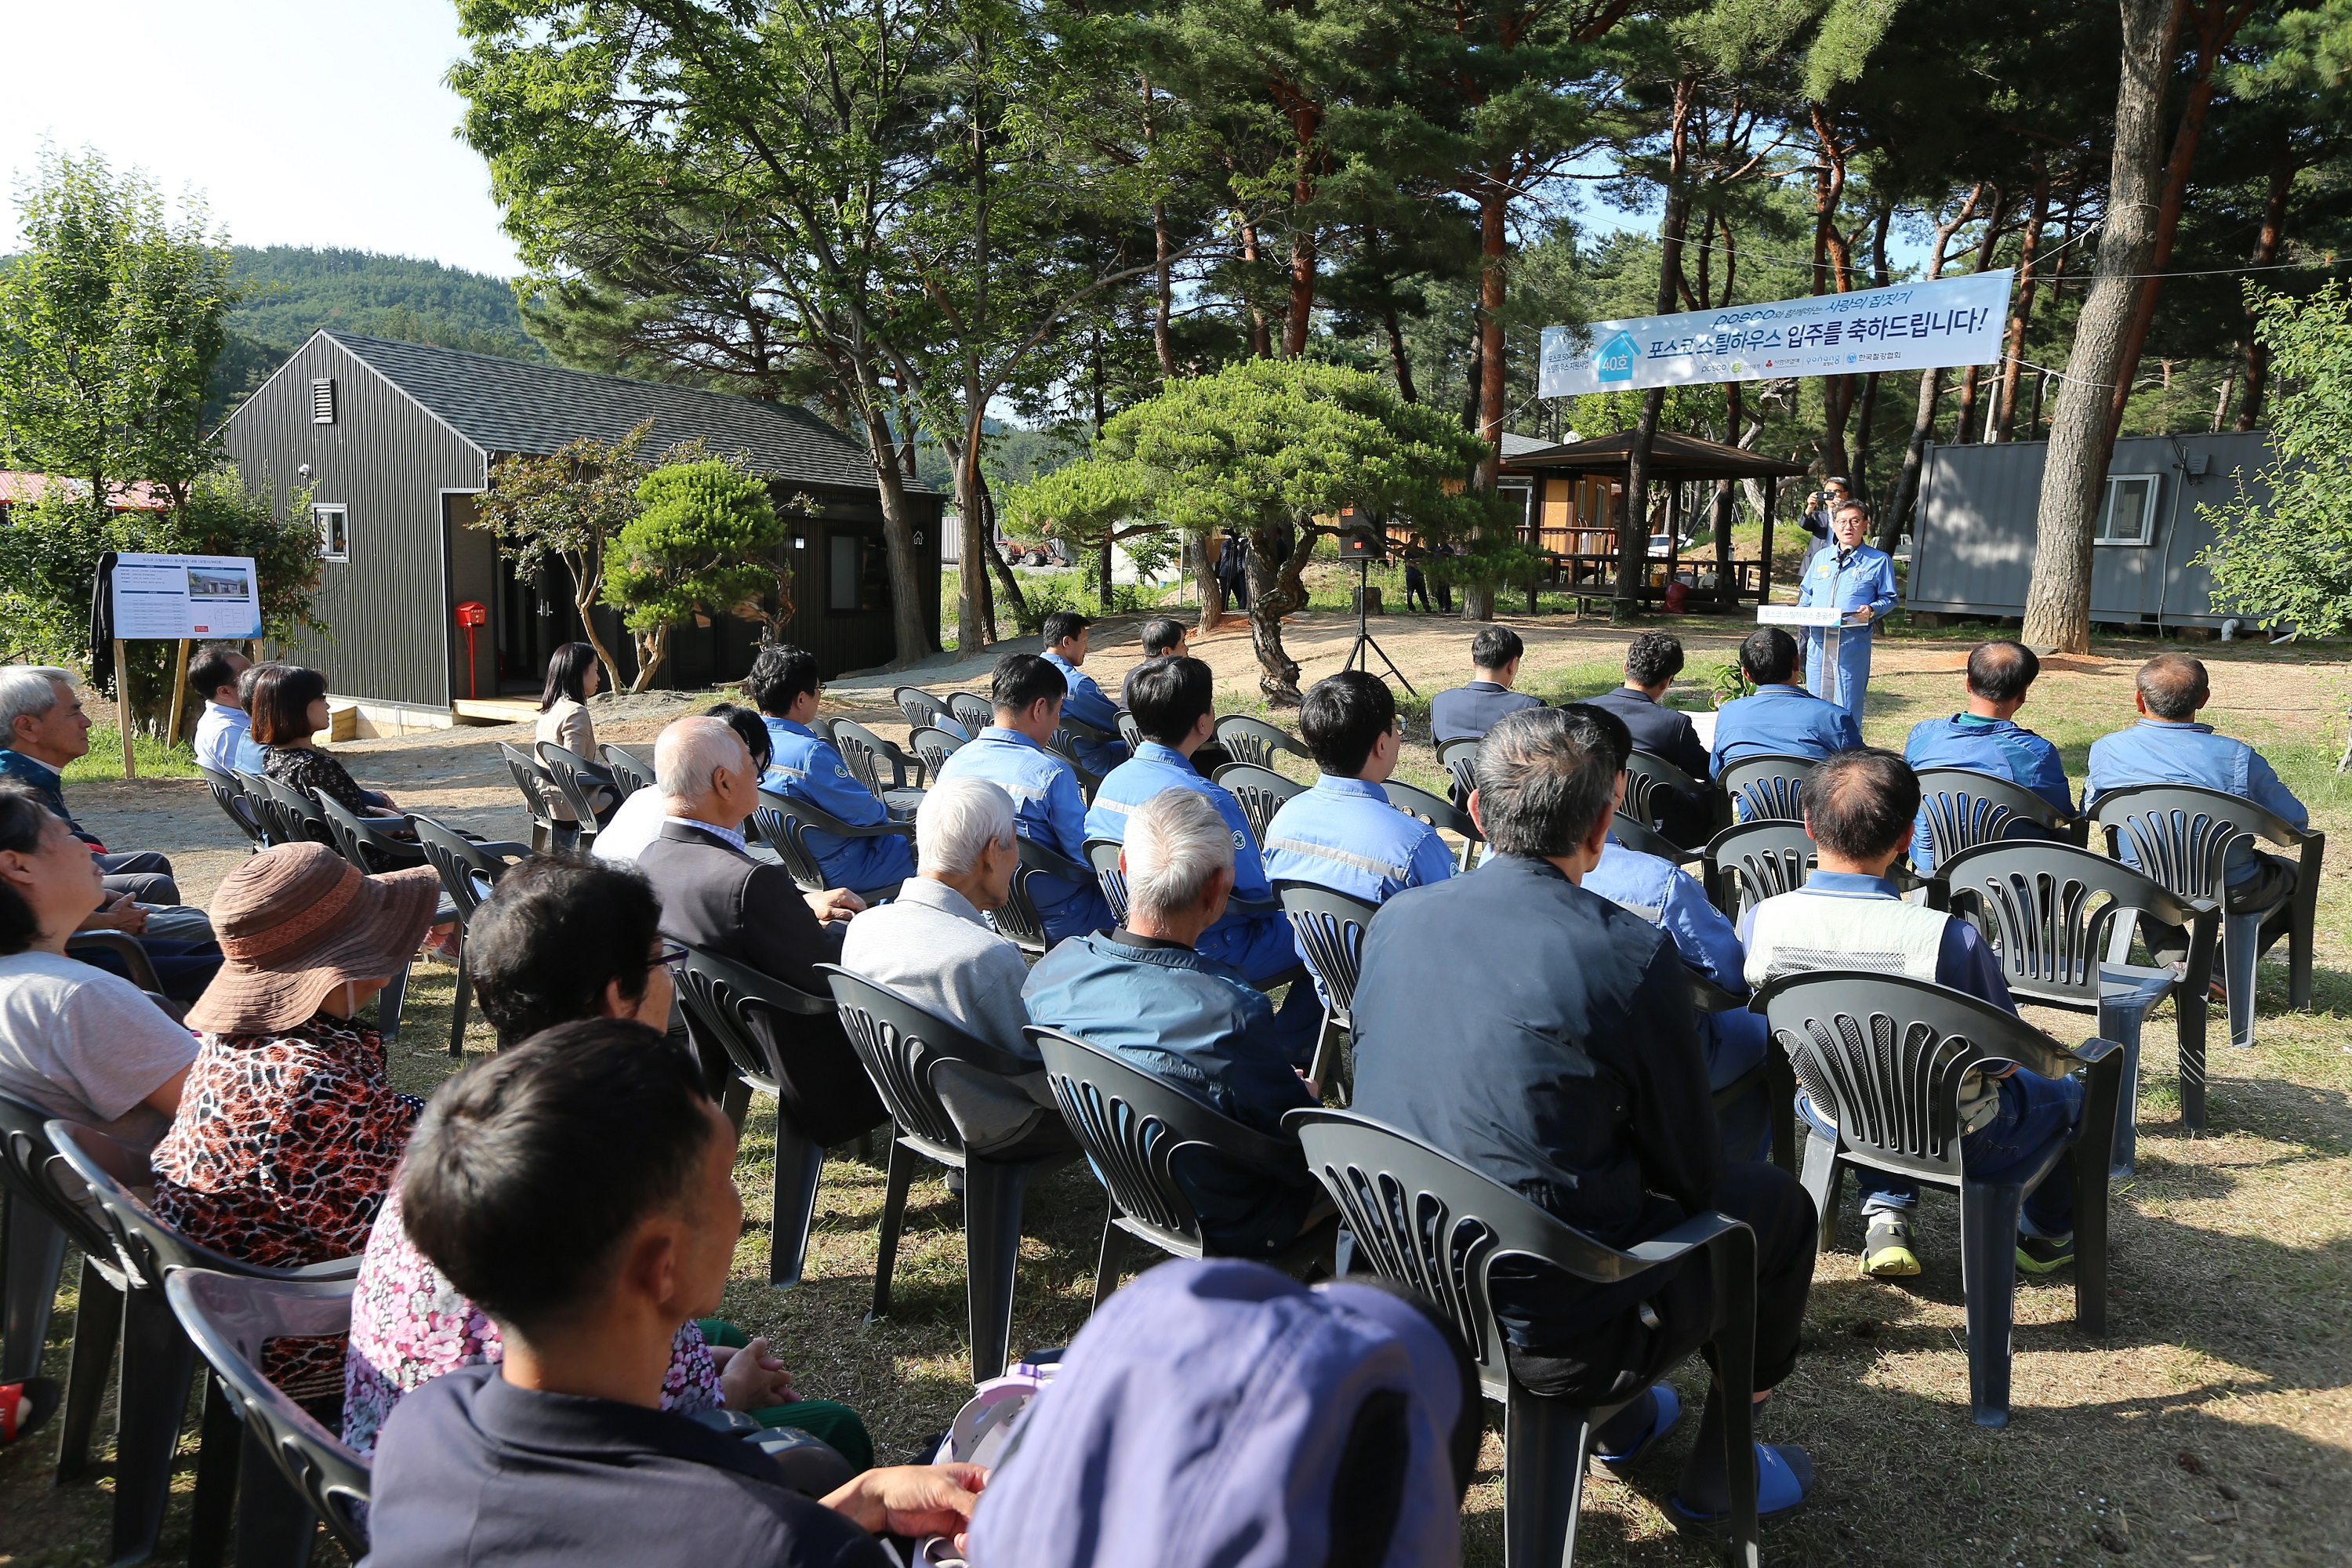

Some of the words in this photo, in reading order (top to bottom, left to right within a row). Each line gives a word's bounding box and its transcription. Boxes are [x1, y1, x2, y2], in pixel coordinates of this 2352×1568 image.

[1784, 307, 1823, 318] 함께하는
[1825, 296, 1867, 312] 사랑의
[1868, 290, 1913, 308] 집짓기
[1647, 338, 1694, 359] 포스코
[1697, 328, 1781, 355] 스틸하우스
[1788, 320, 1842, 349] 입주를
[1847, 307, 1989, 343] 축하드립니다!
[1548, 354, 1561, 362] 포스코
[1859, 351, 1901, 361] 한국철강협회
[1546, 363, 1569, 373] 스틸하우스
[1570, 361, 1589, 370] 지원사업
[1602, 354, 1628, 372] 40호
[1784, 611, 1813, 619] 스틸하우스
[1815, 612, 1835, 620] 준공식
